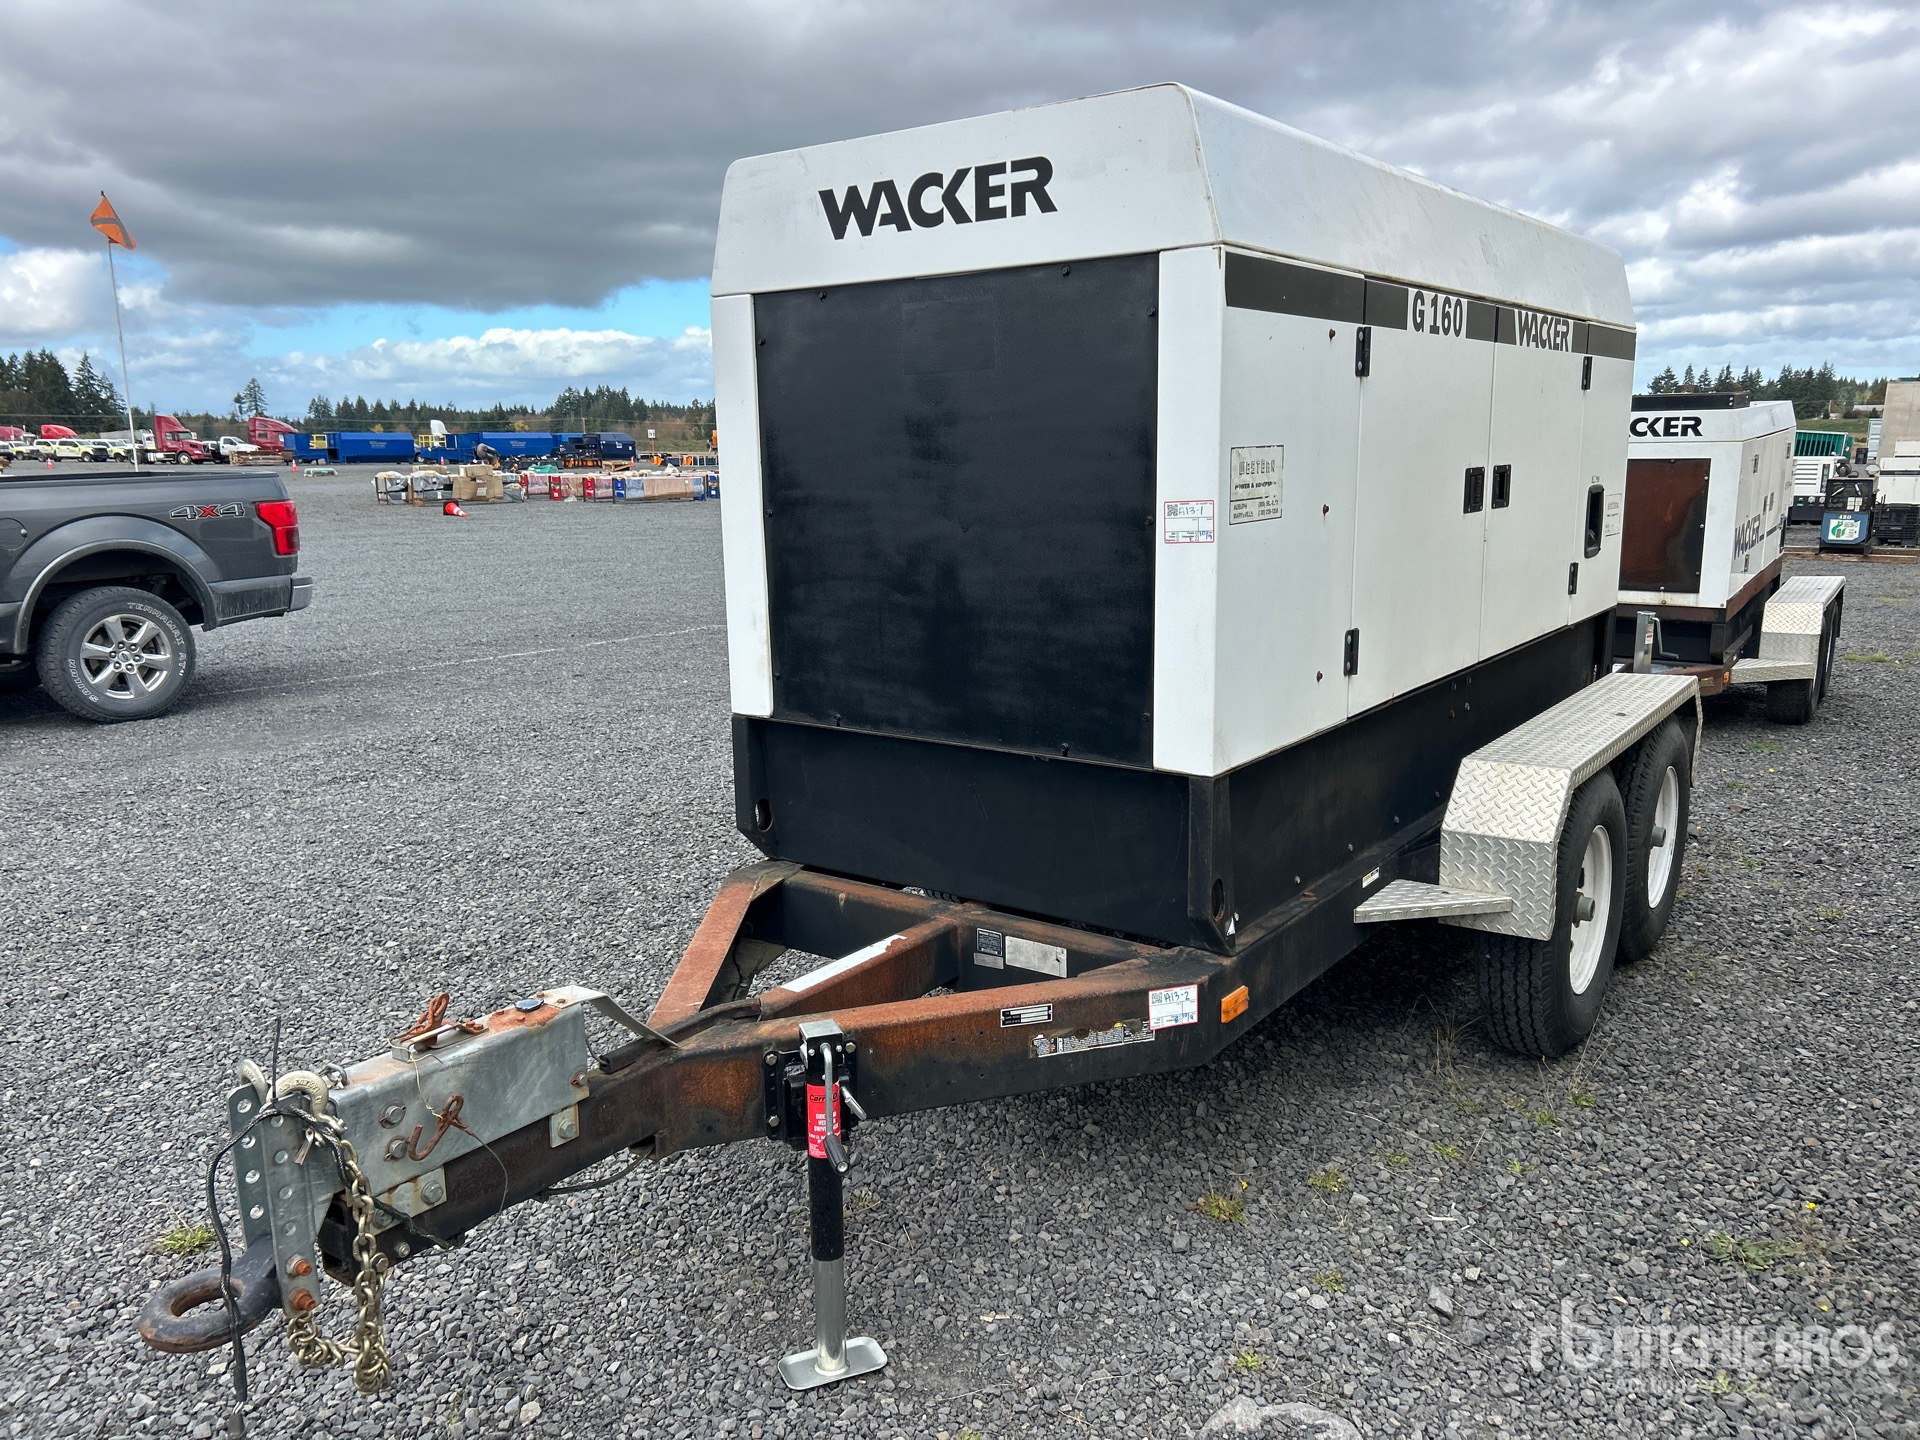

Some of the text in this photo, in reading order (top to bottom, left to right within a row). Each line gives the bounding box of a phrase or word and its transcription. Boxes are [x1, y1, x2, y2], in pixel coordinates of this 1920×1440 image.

[818, 156, 1058, 240] WACKER
[1412, 290, 1463, 338] G 160
[1517, 310, 1570, 352] WACKER
[1629, 416, 1703, 437] CKER
[1239, 460, 1275, 475] WESTERN
[1178, 505, 1204, 516] A13-1
[1733, 514, 1761, 561] WACKER
[126, 602, 186, 646] TERRAMAX
[68, 658, 99, 703] SAILUN
[1163, 991, 1191, 1003] A13-2
